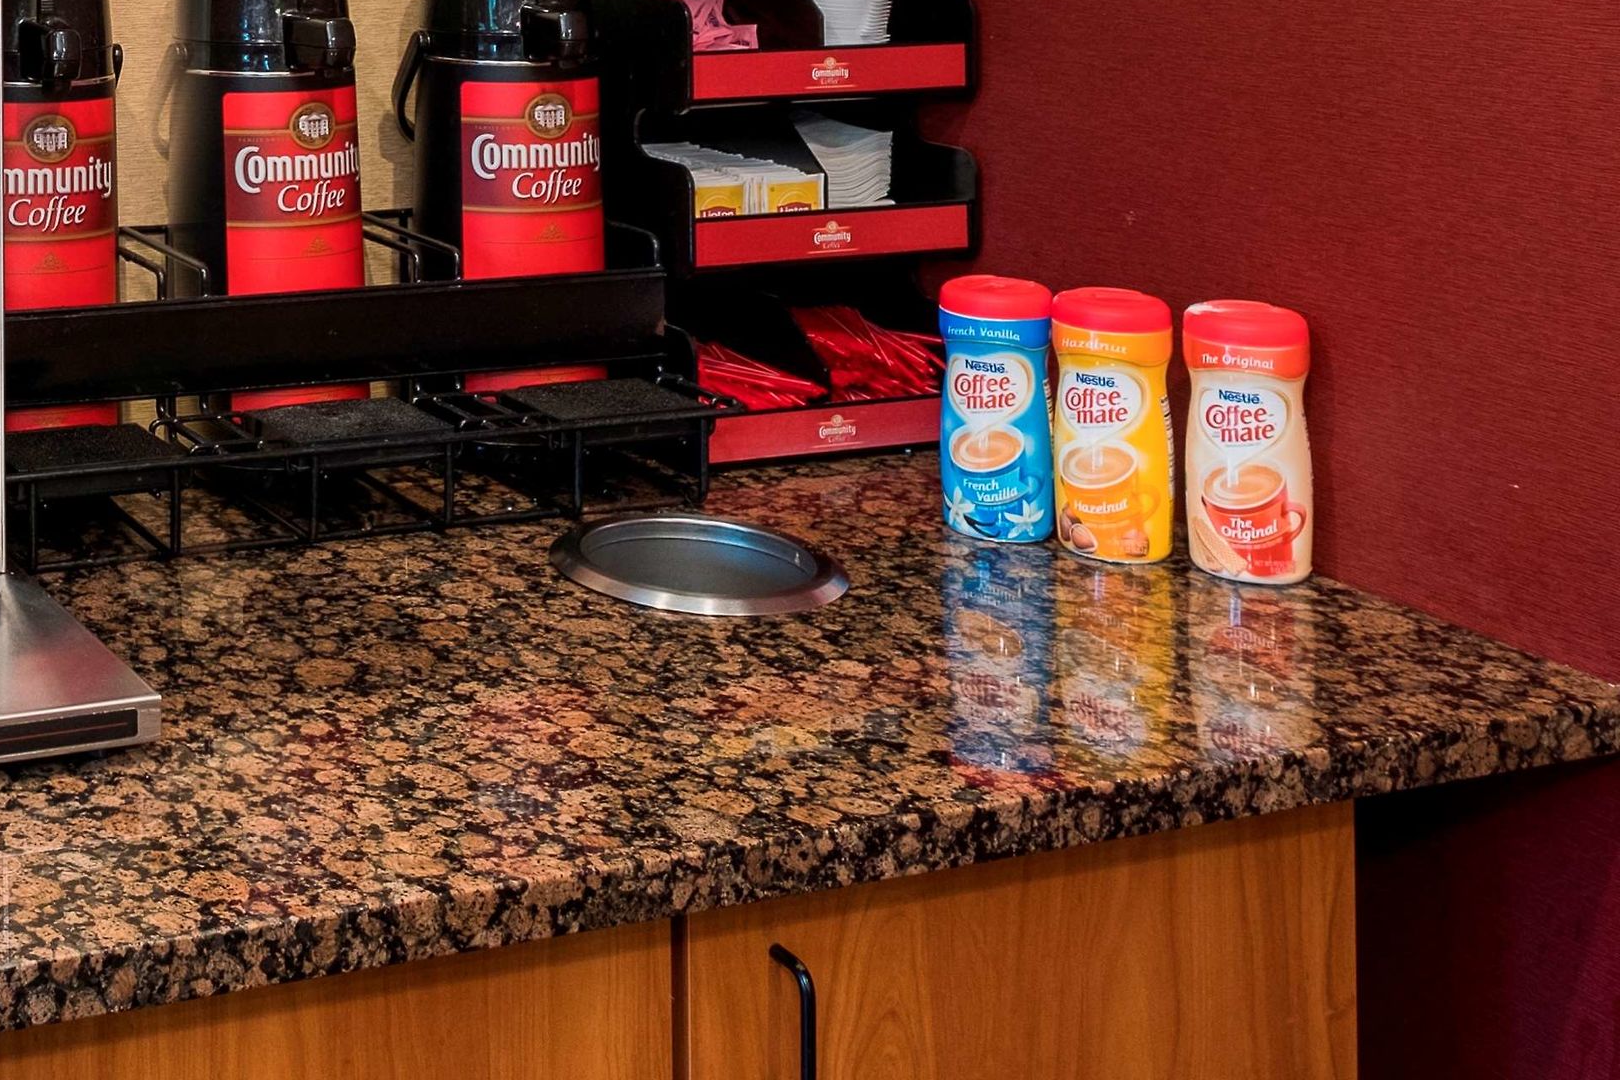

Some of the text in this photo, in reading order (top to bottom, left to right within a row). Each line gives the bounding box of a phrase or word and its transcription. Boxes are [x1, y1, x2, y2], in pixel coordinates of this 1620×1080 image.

[812, 67, 849, 80] Community
[471, 132, 601, 180] Community
[4, 156, 112, 199] mmunity
[511, 169, 582, 204] Coffee
[277, 180, 345, 217] Coffee
[8, 195, 87, 232] Coffee
[814, 231, 851, 245] Community
[948, 326, 1020, 341] French Vanilla
[1202, 353, 1274, 369] The Original
[966, 392, 1017, 409] mate
[1076, 407, 1129, 424] mate
[819, 424, 856, 439] Community
[1220, 424, 1276, 443] mate
[963, 479, 999, 491] French
[976, 486, 1018, 502] Vanilla
[1074, 498, 1129, 514] Hazelnut
[1221, 519, 1278, 542] Original
[1228, 517, 1253, 529] The
